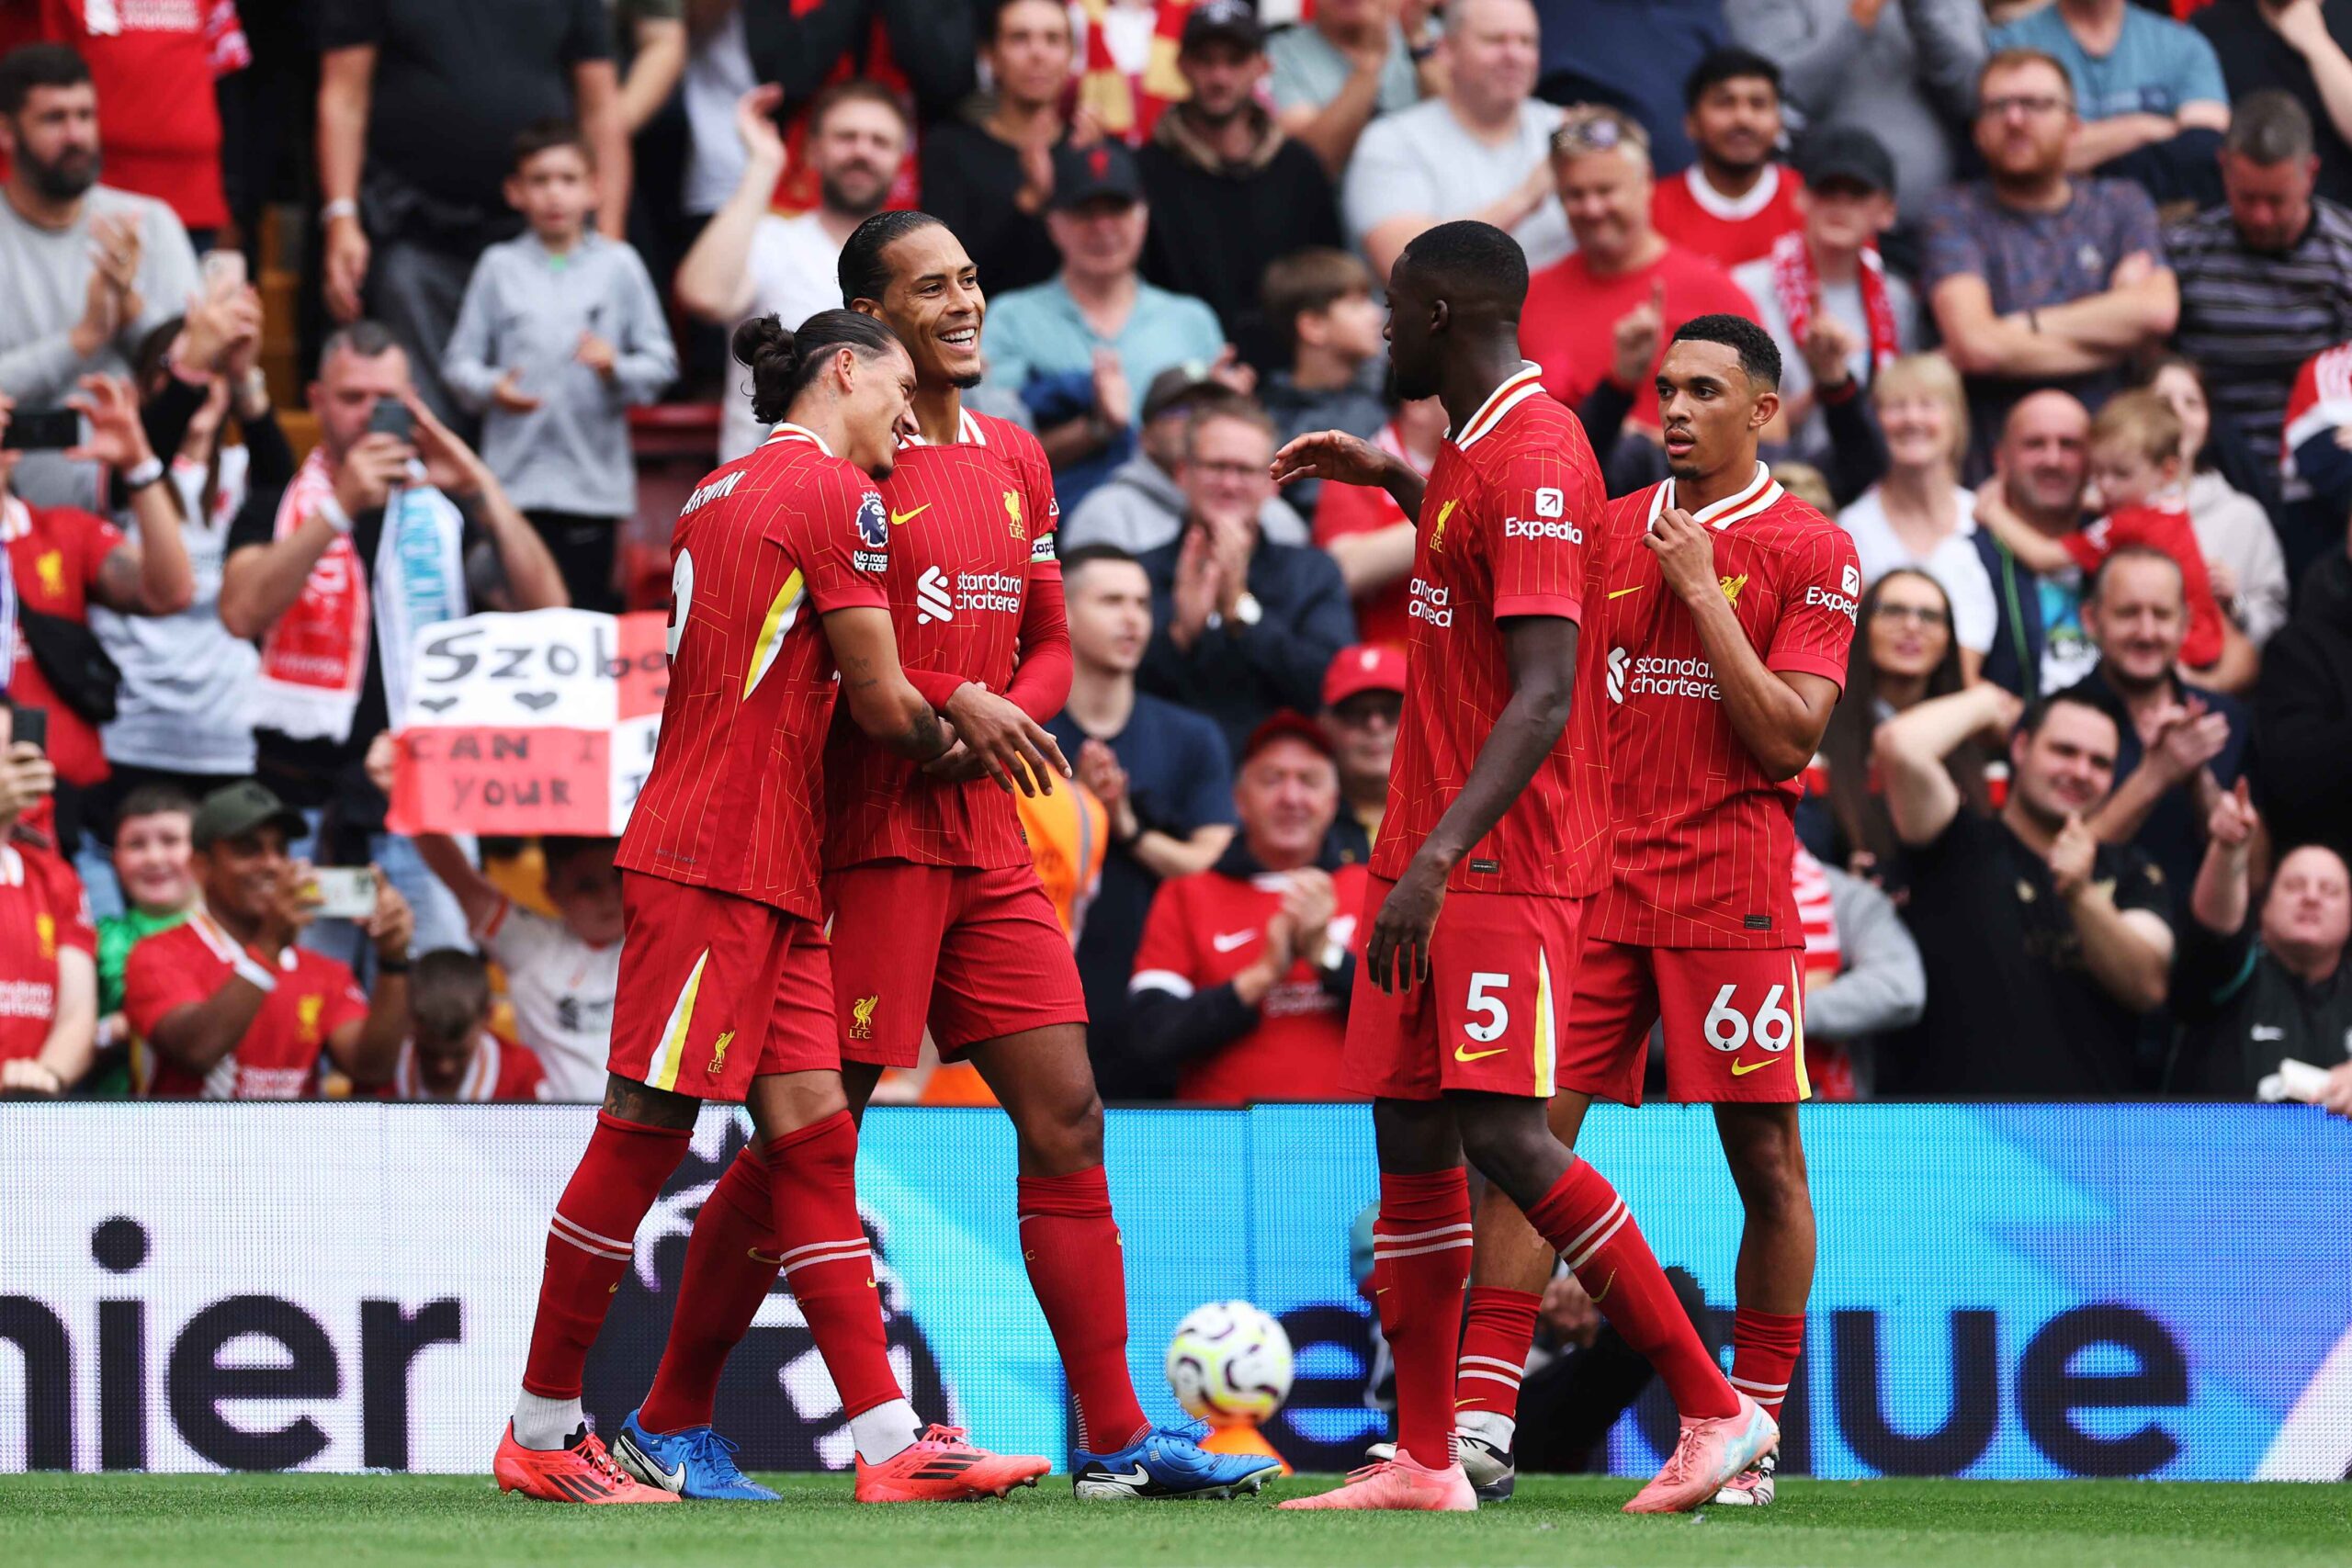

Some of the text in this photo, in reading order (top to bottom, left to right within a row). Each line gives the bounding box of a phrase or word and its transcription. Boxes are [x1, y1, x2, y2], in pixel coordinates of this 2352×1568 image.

[1505, 517, 1583, 545] Expedia
[854, 550, 868, 561] No
[408, 734, 598, 762] CAN I
[451, 778, 571, 809] YOUR
[1464, 972, 1510, 1043] 5
[1703, 984, 1793, 1052] 66
